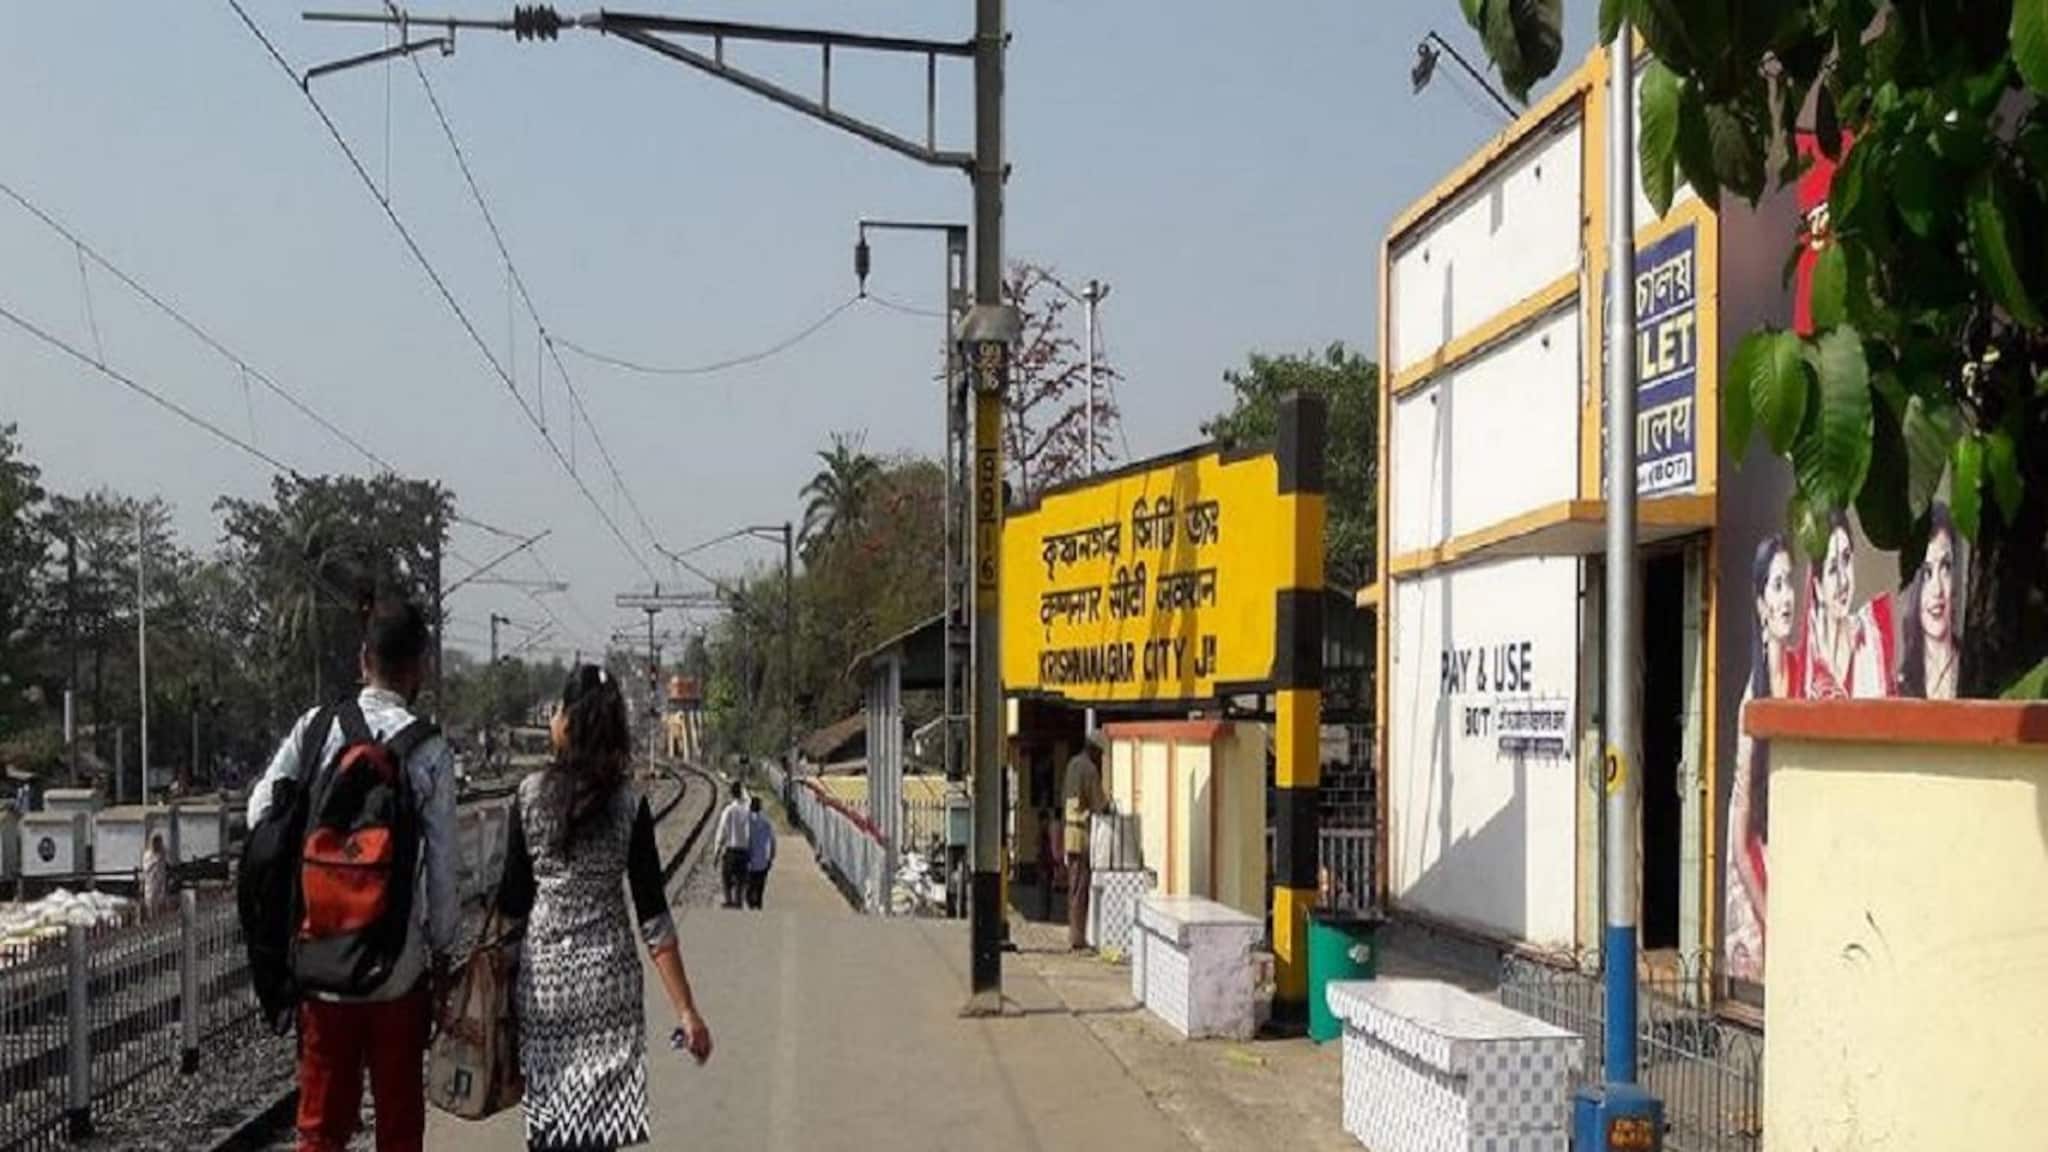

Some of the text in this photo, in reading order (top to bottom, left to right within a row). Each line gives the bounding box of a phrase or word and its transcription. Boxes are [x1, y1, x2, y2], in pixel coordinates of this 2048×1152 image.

[1143, 637, 1187, 680] CITY
[1440, 641, 1532, 695] PAY & USE
